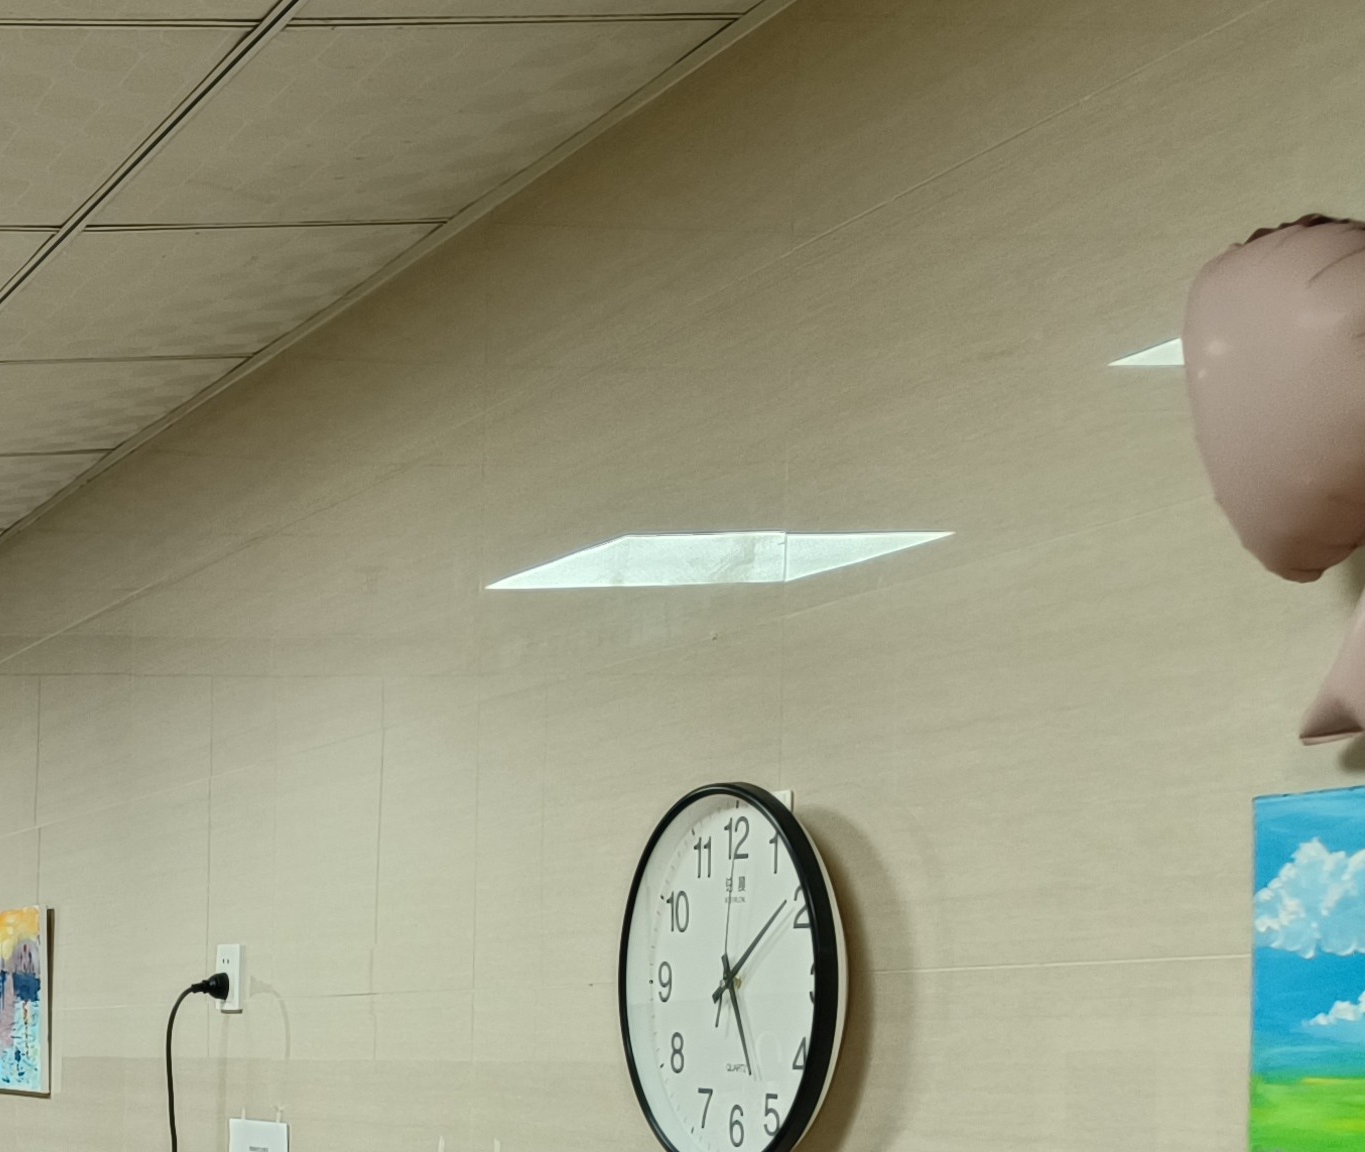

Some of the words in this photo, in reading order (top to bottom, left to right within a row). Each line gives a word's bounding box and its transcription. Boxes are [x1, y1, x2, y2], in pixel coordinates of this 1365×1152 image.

[693, 837, 713, 878] 11
[724, 816, 750, 861] 12
[768, 833, 779, 874] 1
[667, 890, 690, 933] 10
[792, 885, 811, 929] 2
[658, 960, 673, 1003] 9
[670, 1031, 685, 1074] 8
[791, 1036, 807, 1071] 4
[697, 1087, 713, 1129] 7
[729, 1104, 745, 1147] 6
[763, 1093, 781, 1137] 5
